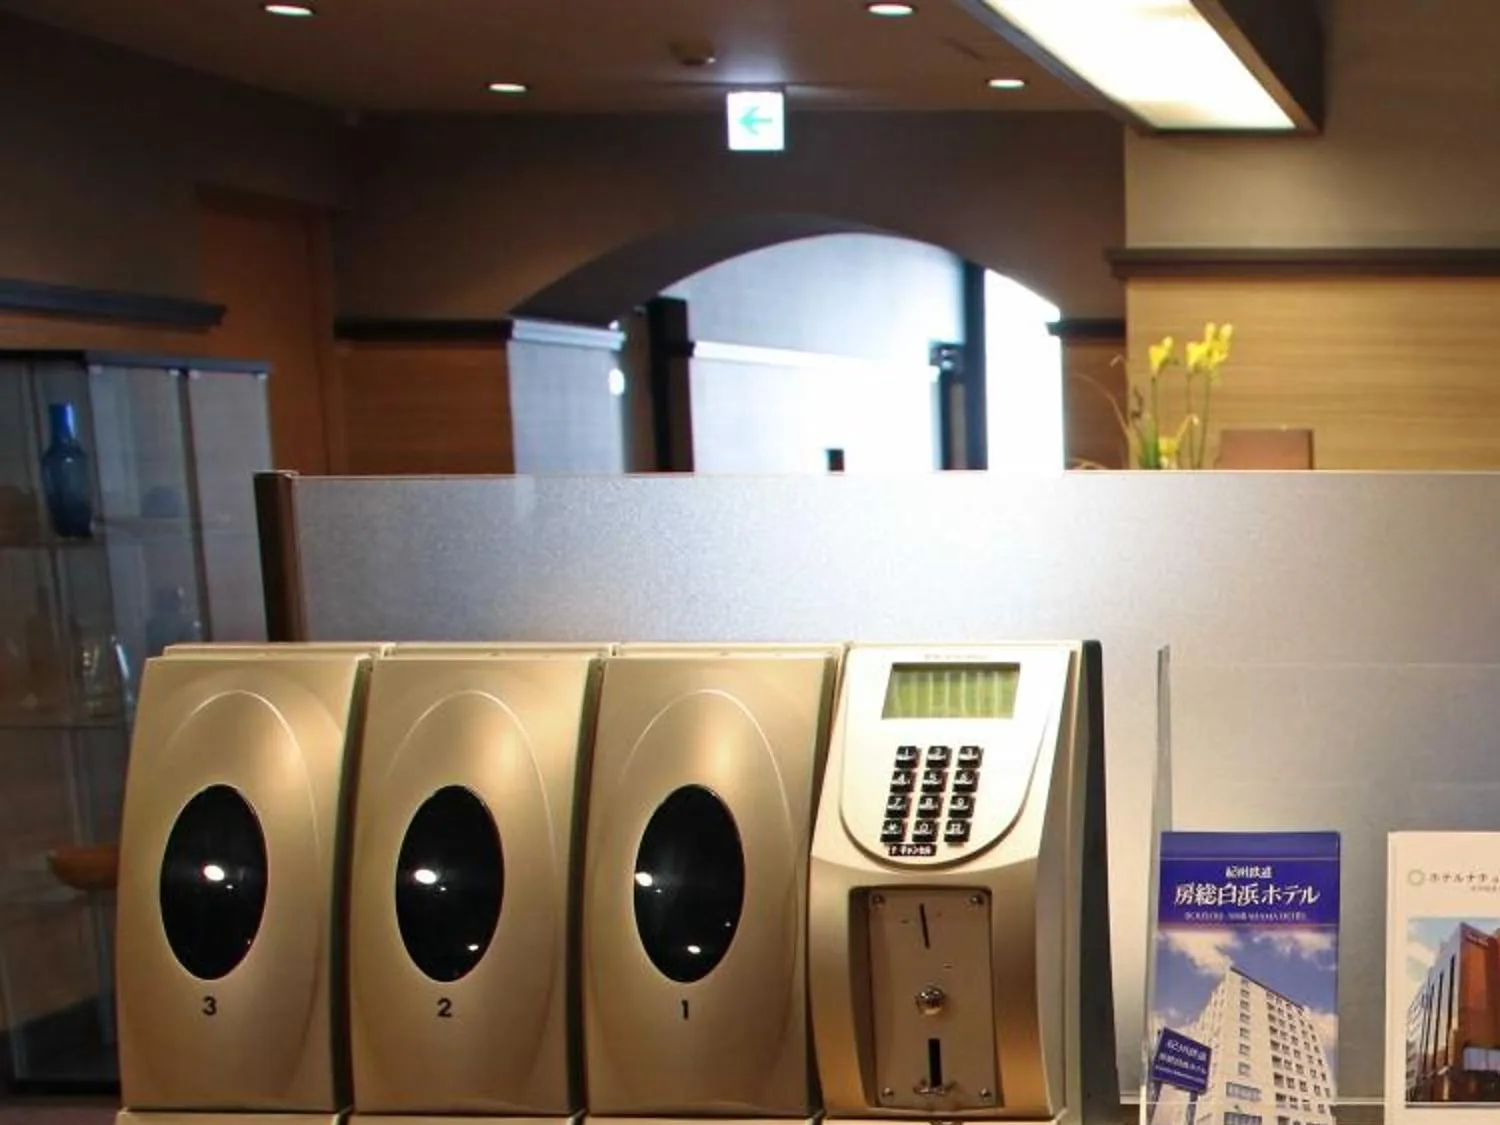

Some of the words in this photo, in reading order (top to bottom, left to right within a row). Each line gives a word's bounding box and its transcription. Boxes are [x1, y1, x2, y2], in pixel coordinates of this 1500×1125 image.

[1225, 866, 1273, 879] 紀州鉄道
[1174, 881, 1321, 907] 房総白浜ホテル
[202, 996, 217, 1016] 3
[437, 998, 452, 1018] 2
[680, 1000, 688, 1019] 1
